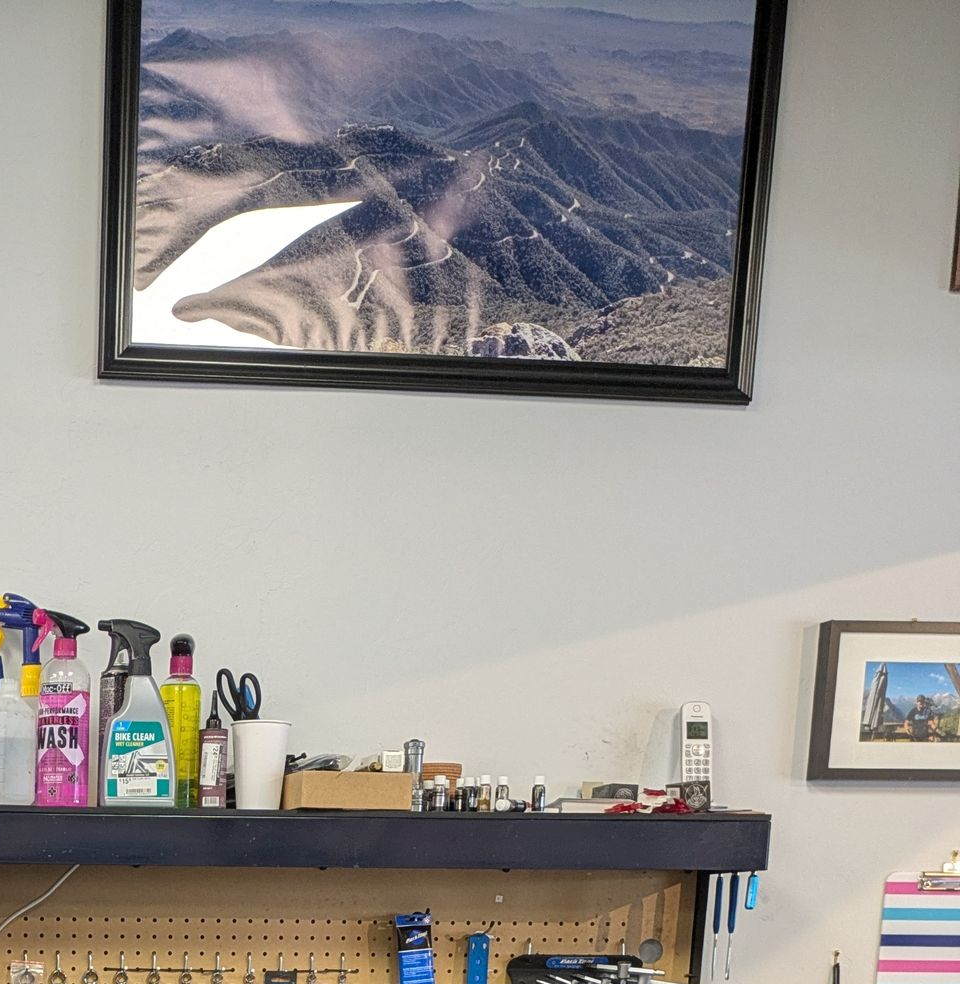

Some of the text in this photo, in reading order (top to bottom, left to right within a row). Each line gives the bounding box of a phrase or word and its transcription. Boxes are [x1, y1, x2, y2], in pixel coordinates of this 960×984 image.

[42, 683, 72, 694] Muc-Off
[115, 732, 155, 741] BIKE CLEAN
